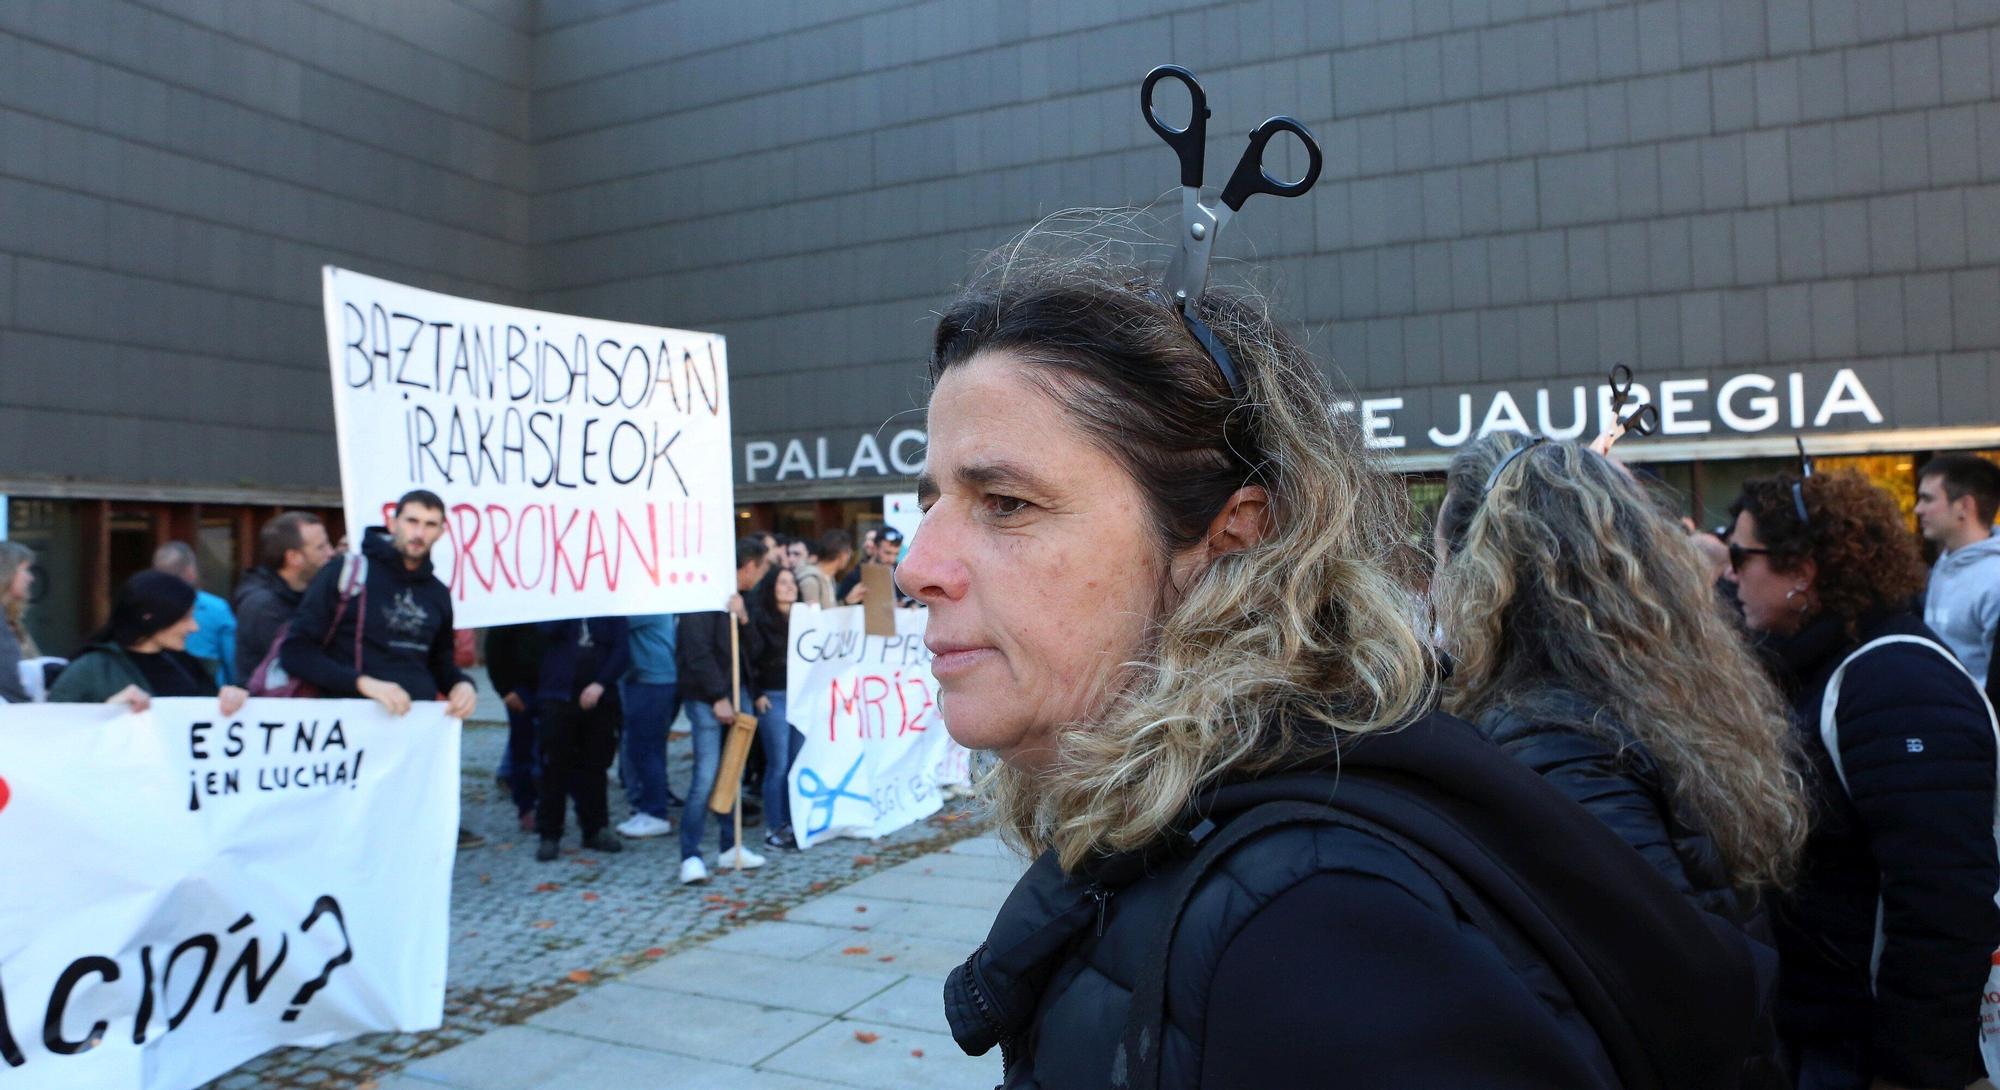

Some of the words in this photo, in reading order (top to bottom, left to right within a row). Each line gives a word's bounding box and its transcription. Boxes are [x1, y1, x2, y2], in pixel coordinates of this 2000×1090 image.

[746, 428, 928, 482] PALAC
[1428, 368, 1884, 447] JAUREGIA
[190, 720, 346, 760] ESTNA
[189, 769, 239, 811] ¡EN
[259, 750, 364, 791] LUCHA!
